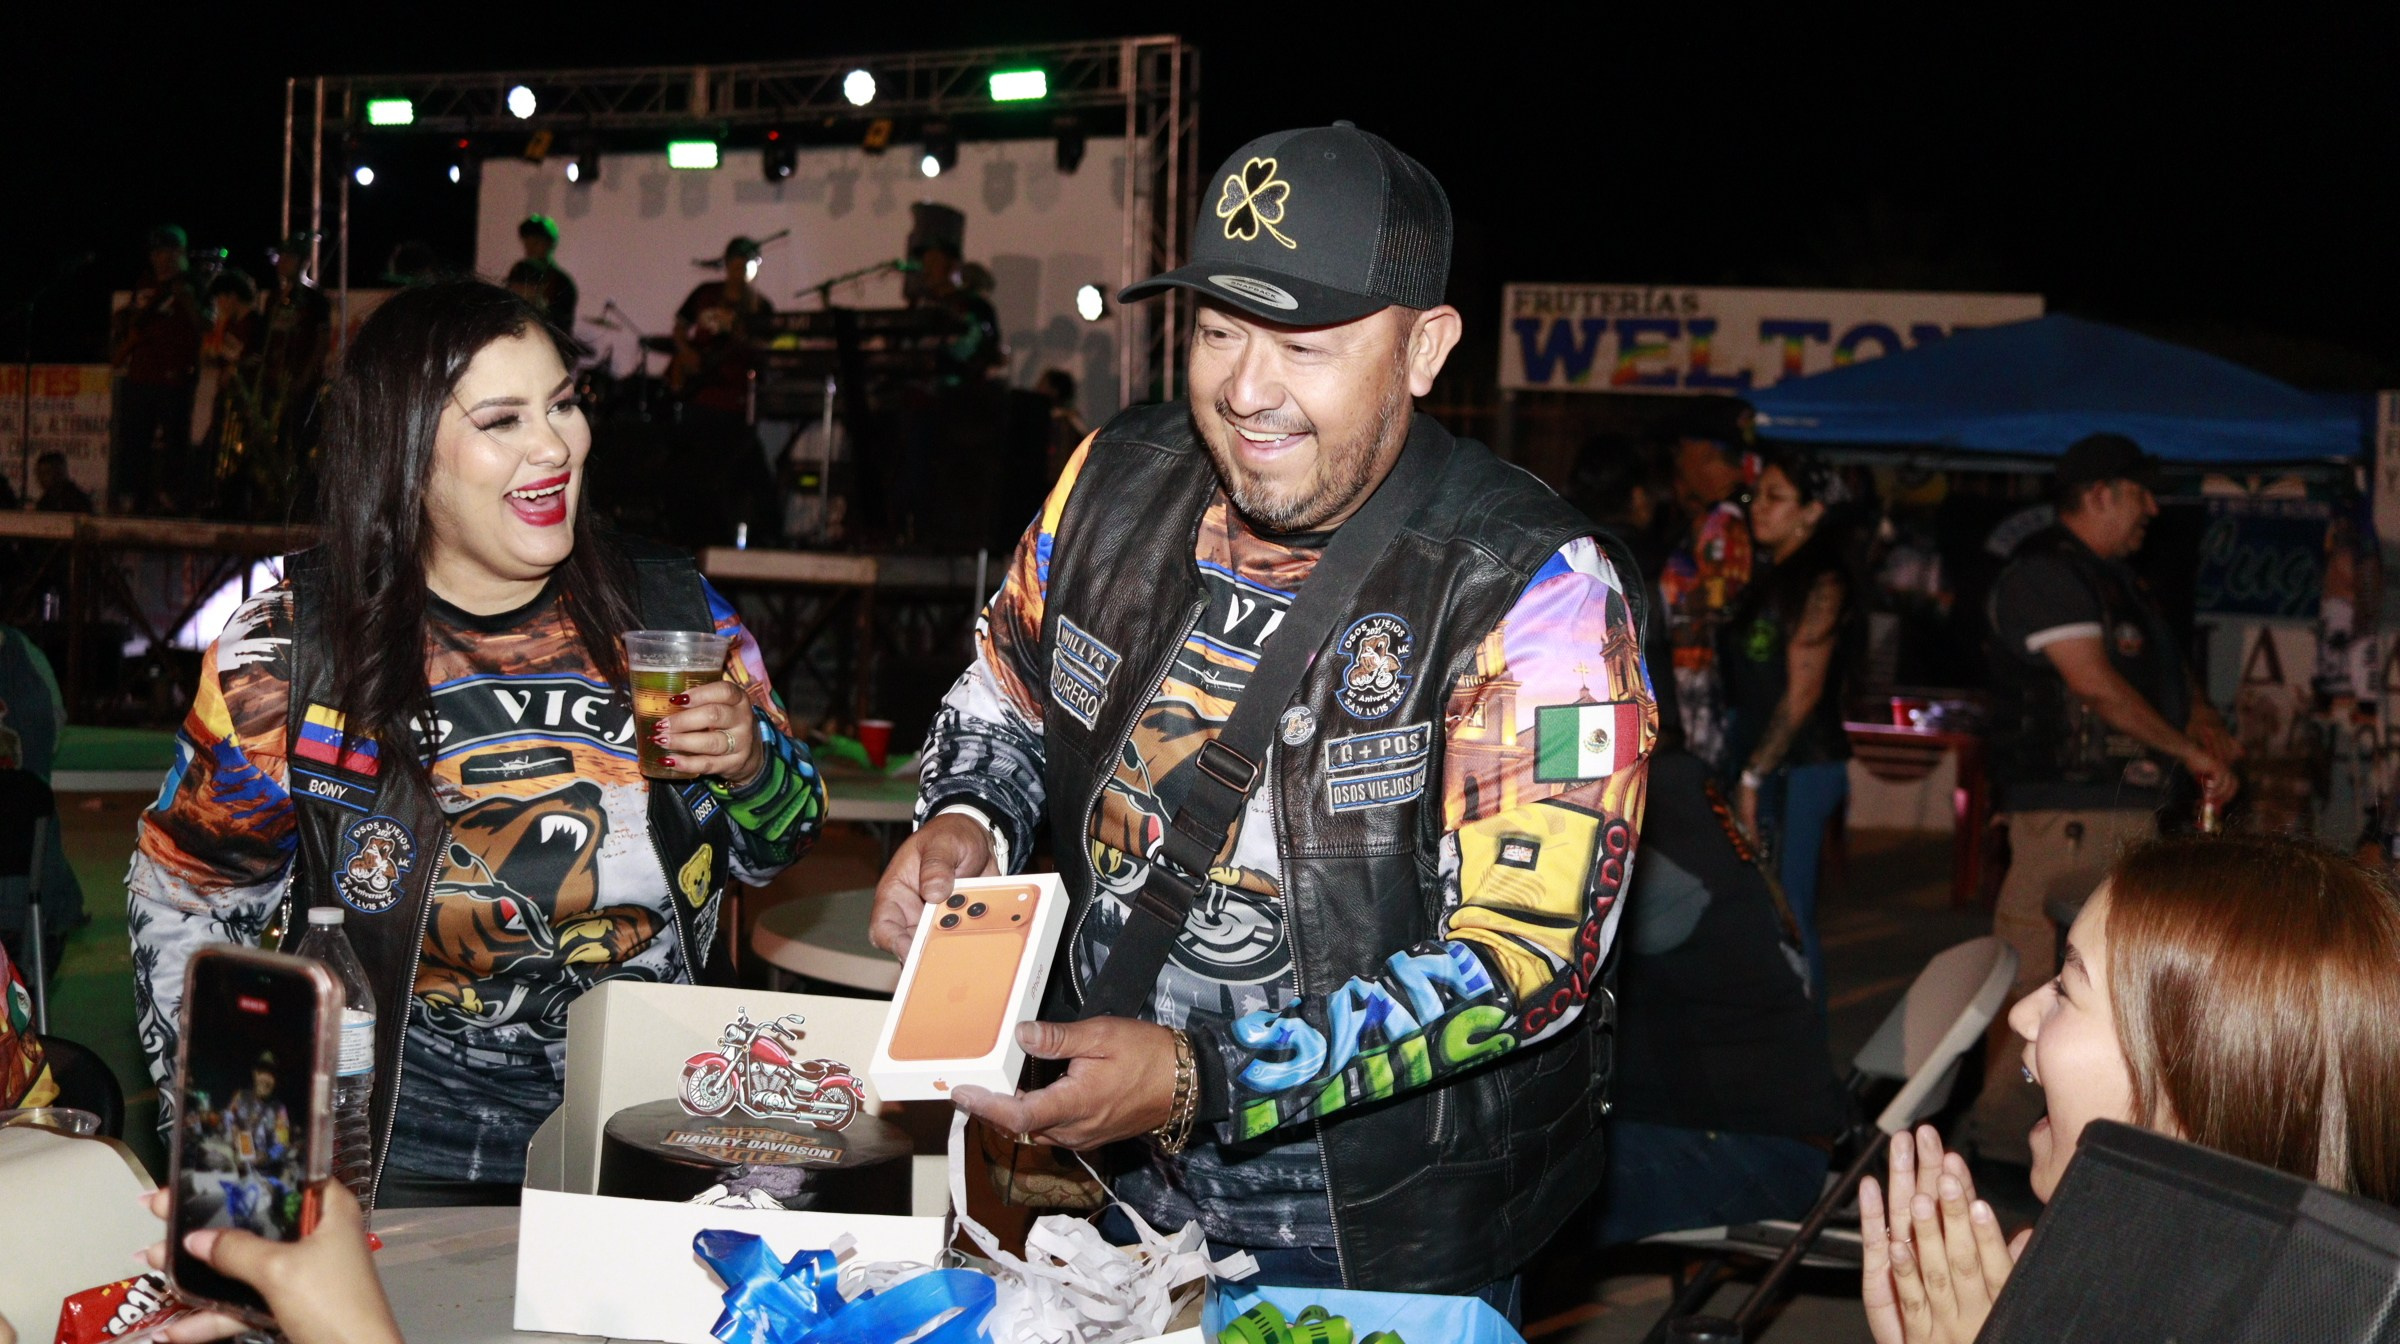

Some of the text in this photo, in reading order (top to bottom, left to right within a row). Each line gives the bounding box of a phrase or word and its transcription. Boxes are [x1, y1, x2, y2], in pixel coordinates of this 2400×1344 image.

[1230, 280, 1277, 299] SNAPBACK
[1513, 286, 1700, 315] FRUTERÍAS
[1513, 317, 1978, 388] WELTO
[1344, 618, 1406, 649] OSOS VIEJOS
[1060, 626, 1108, 672] WILLYS
[1344, 699, 1363, 715] SAN
[1366, 703, 1389, 716] LUIS
[1379, 733, 1421, 756] POS
[308, 778, 348, 801] BONY
[1333, 782, 1366, 804] OSOS
[1367, 774, 1412, 800] VIEJOS
[353, 821, 411, 851] OSOS VIEJOS
[339, 882, 355, 902] SAN
[356, 899, 378, 911] LUIS
[1031, 963, 1044, 1001] iPhone
[1230, 938, 1495, 1092] SAN
[675, 1133, 835, 1160] HARLEY-DAVIDSON
